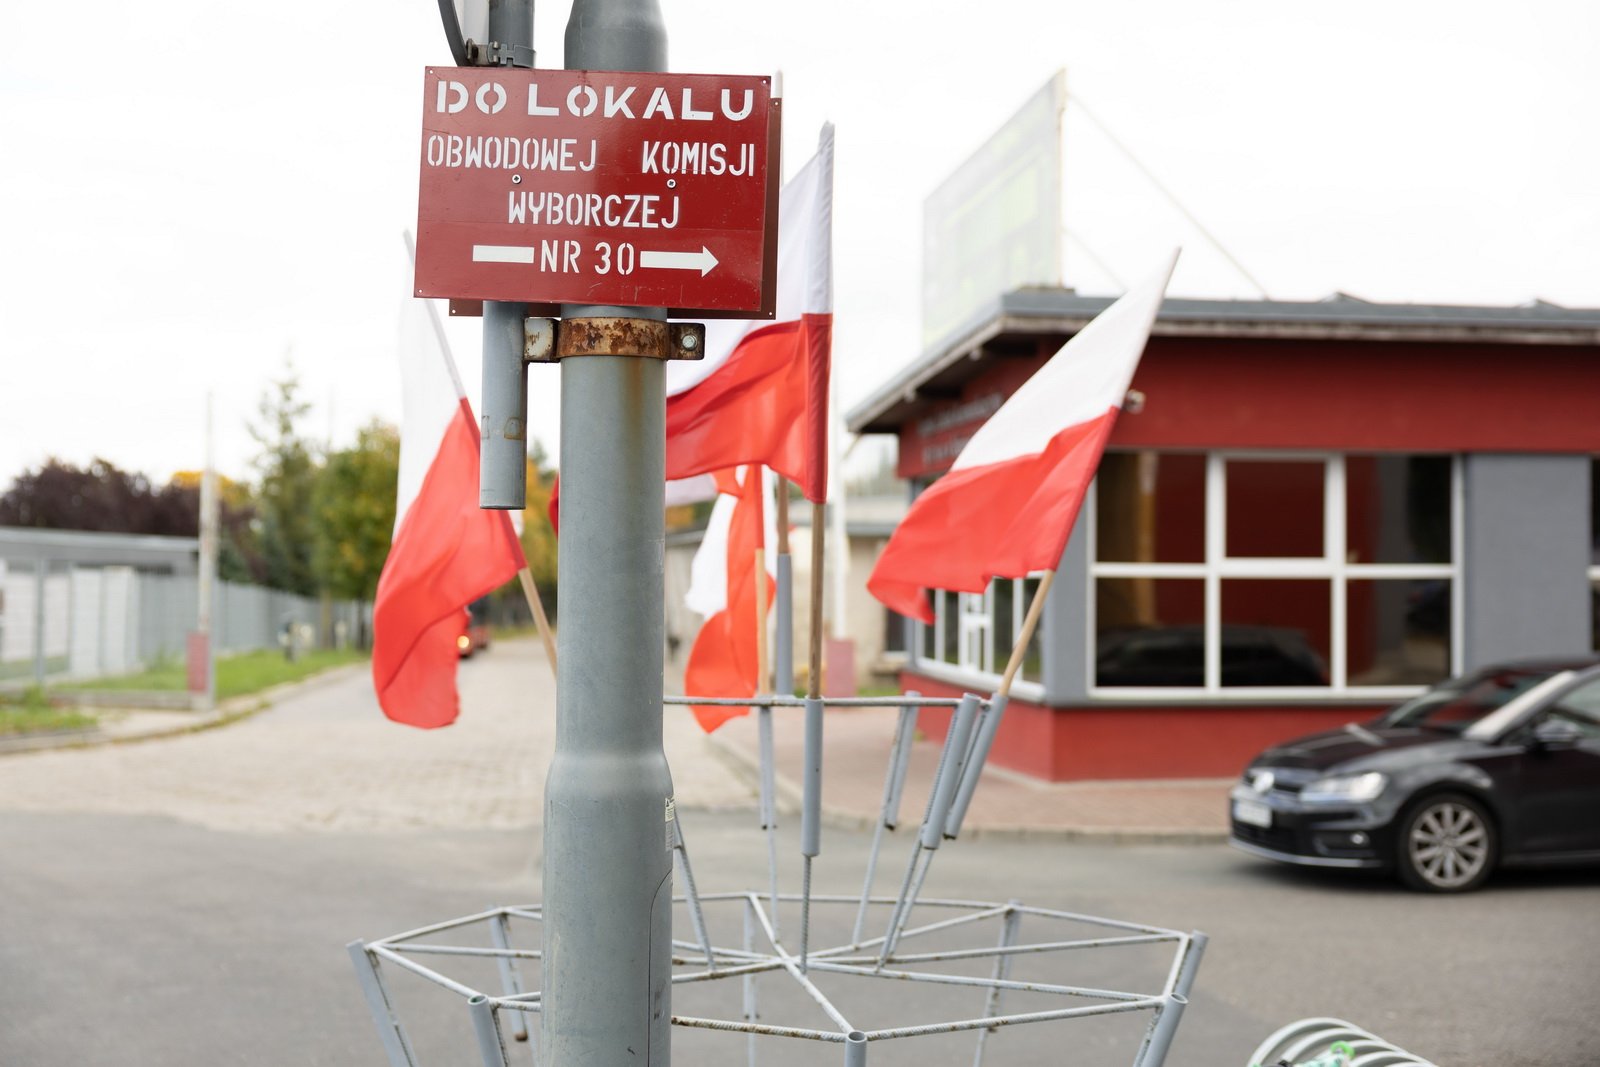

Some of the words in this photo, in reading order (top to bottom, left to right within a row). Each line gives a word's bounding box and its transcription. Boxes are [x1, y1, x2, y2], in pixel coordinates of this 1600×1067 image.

[436, 80, 507, 115] DO
[527, 83, 754, 121] LOKALU
[427, 135, 597, 172] OBWODOWEJ
[642, 140, 754, 177] KOMISJI
[508, 191, 679, 229] WYBORCZEJ
[540, 239, 582, 273] NR
[594, 242, 635, 276] 30
